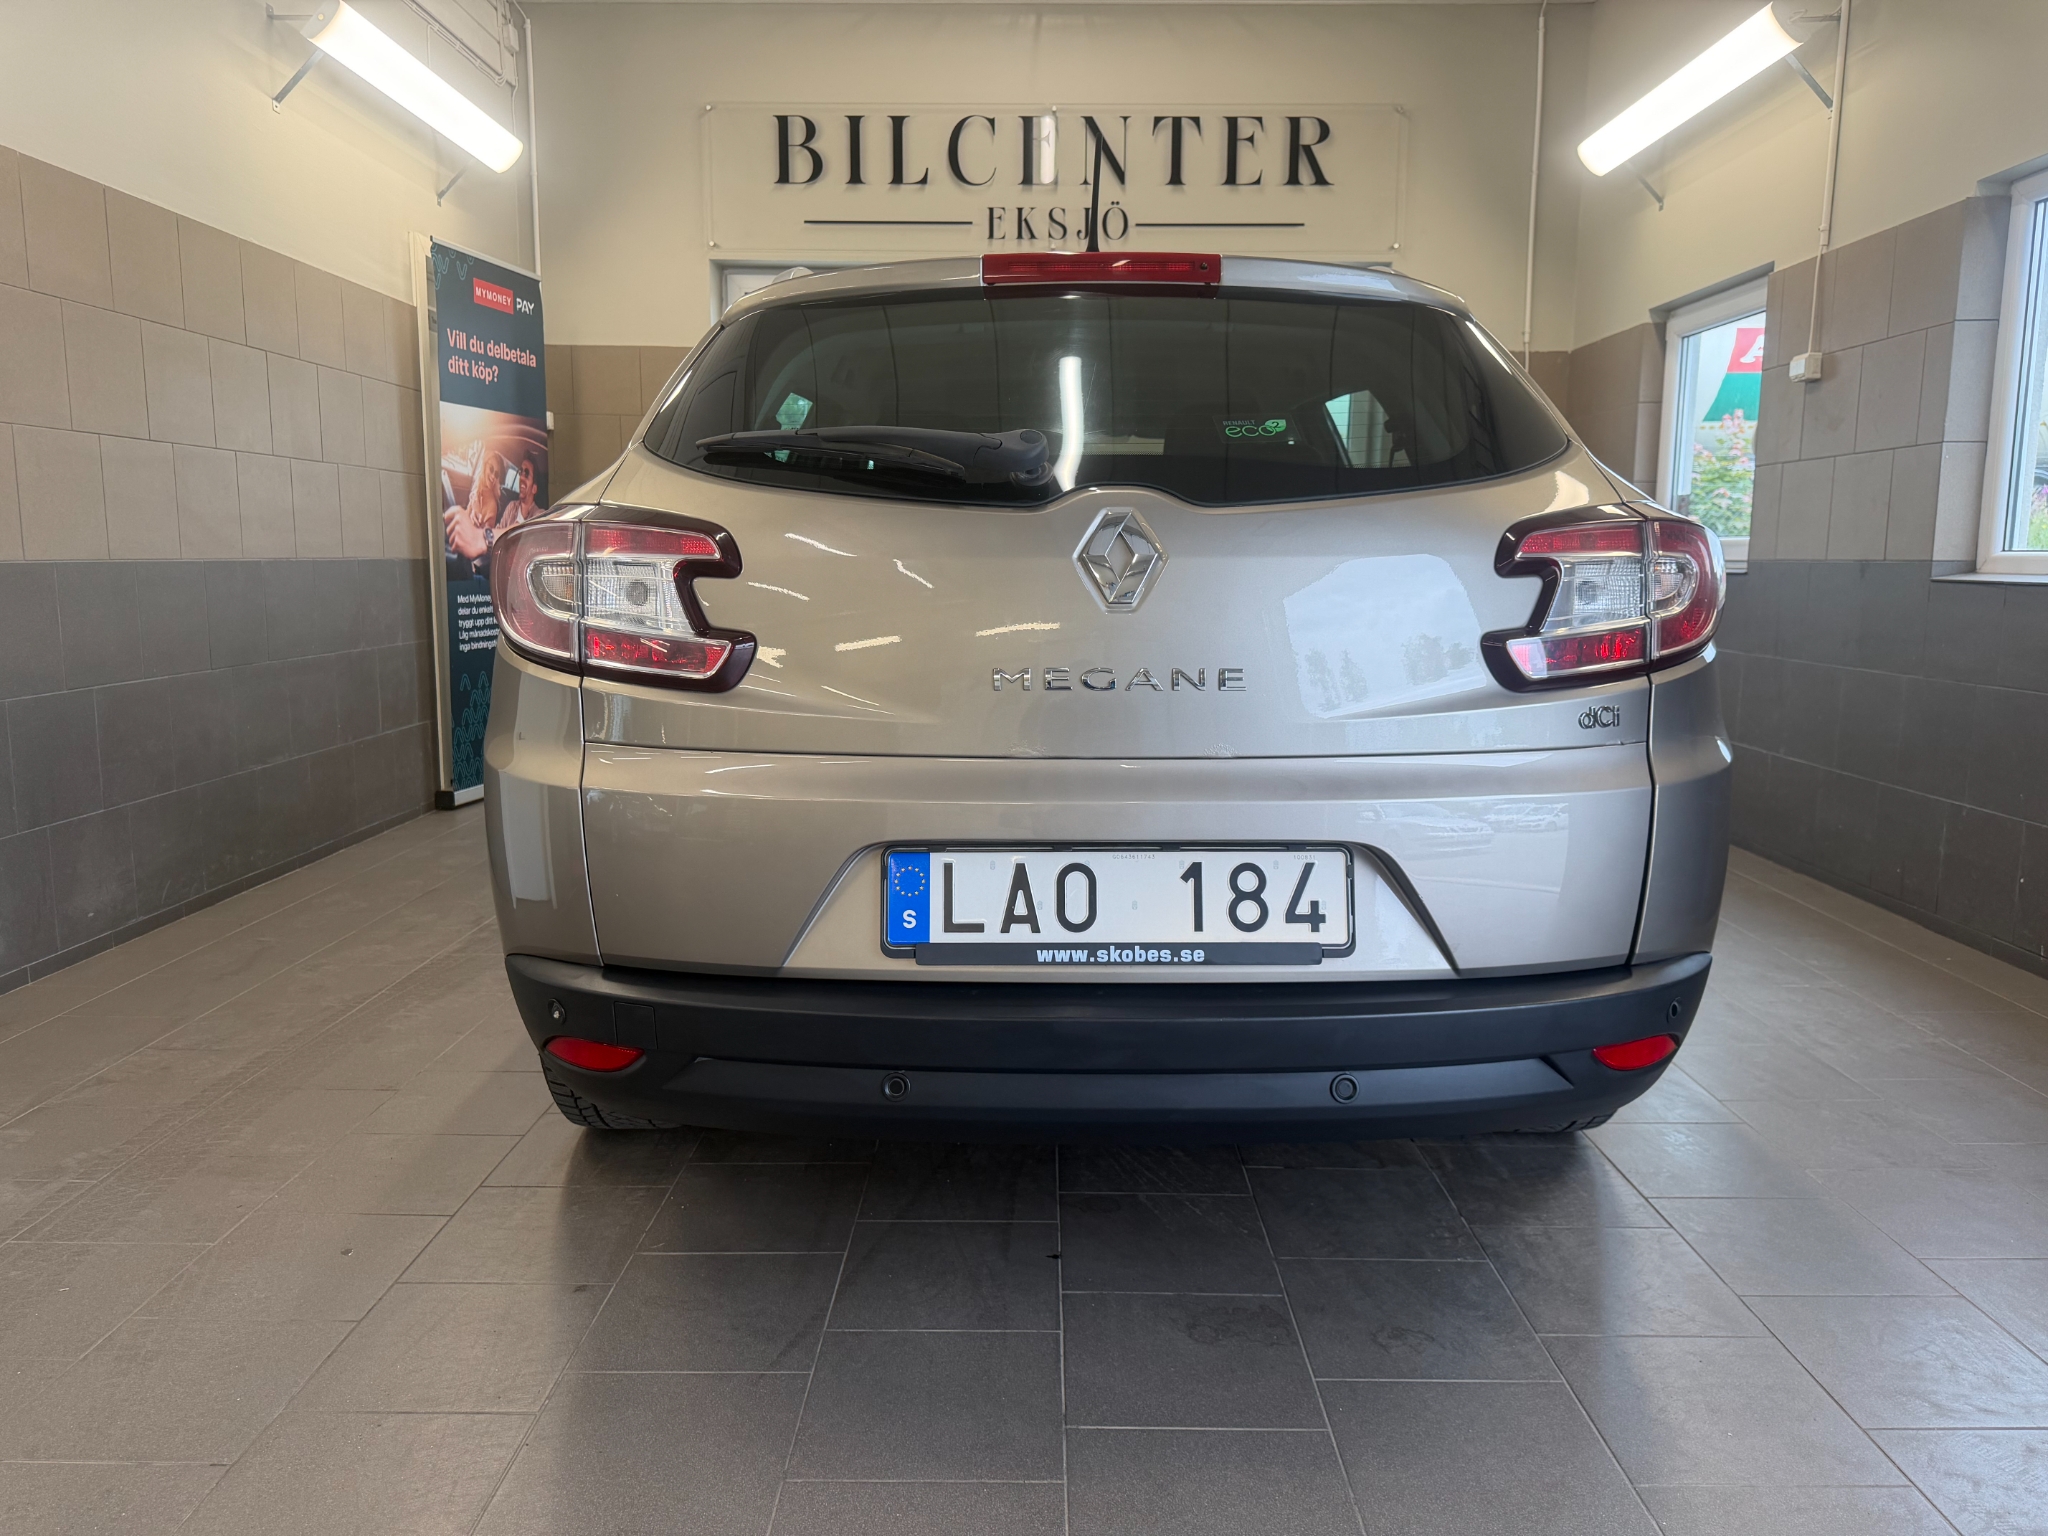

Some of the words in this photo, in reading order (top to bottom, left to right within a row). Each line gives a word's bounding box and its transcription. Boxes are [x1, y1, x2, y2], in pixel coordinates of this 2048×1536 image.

[772, 114, 1335, 187] BILCENTER
[987, 201, 1130, 241] EKSJÖ
[475, 286, 511, 306] MYMONEY
[516, 298, 534, 315] PAY
[447, 328, 466, 350] Vill
[469, 335, 484, 354] du
[487, 340, 536, 367] delbetala
[448, 356, 469, 376] ditt
[472, 360, 498, 385] köp?
[472, 606, 478, 614] du
[475, 618, 485, 627] upp
[992, 667, 1248, 692] MEGANE
[1578, 705, 1620, 729] dCi
[942, 862, 1098, 934] LAO
[1179, 861, 1327, 934] 184
[902, 909, 917, 930] S
[1036, 945, 1205, 964] www.skobes.se
